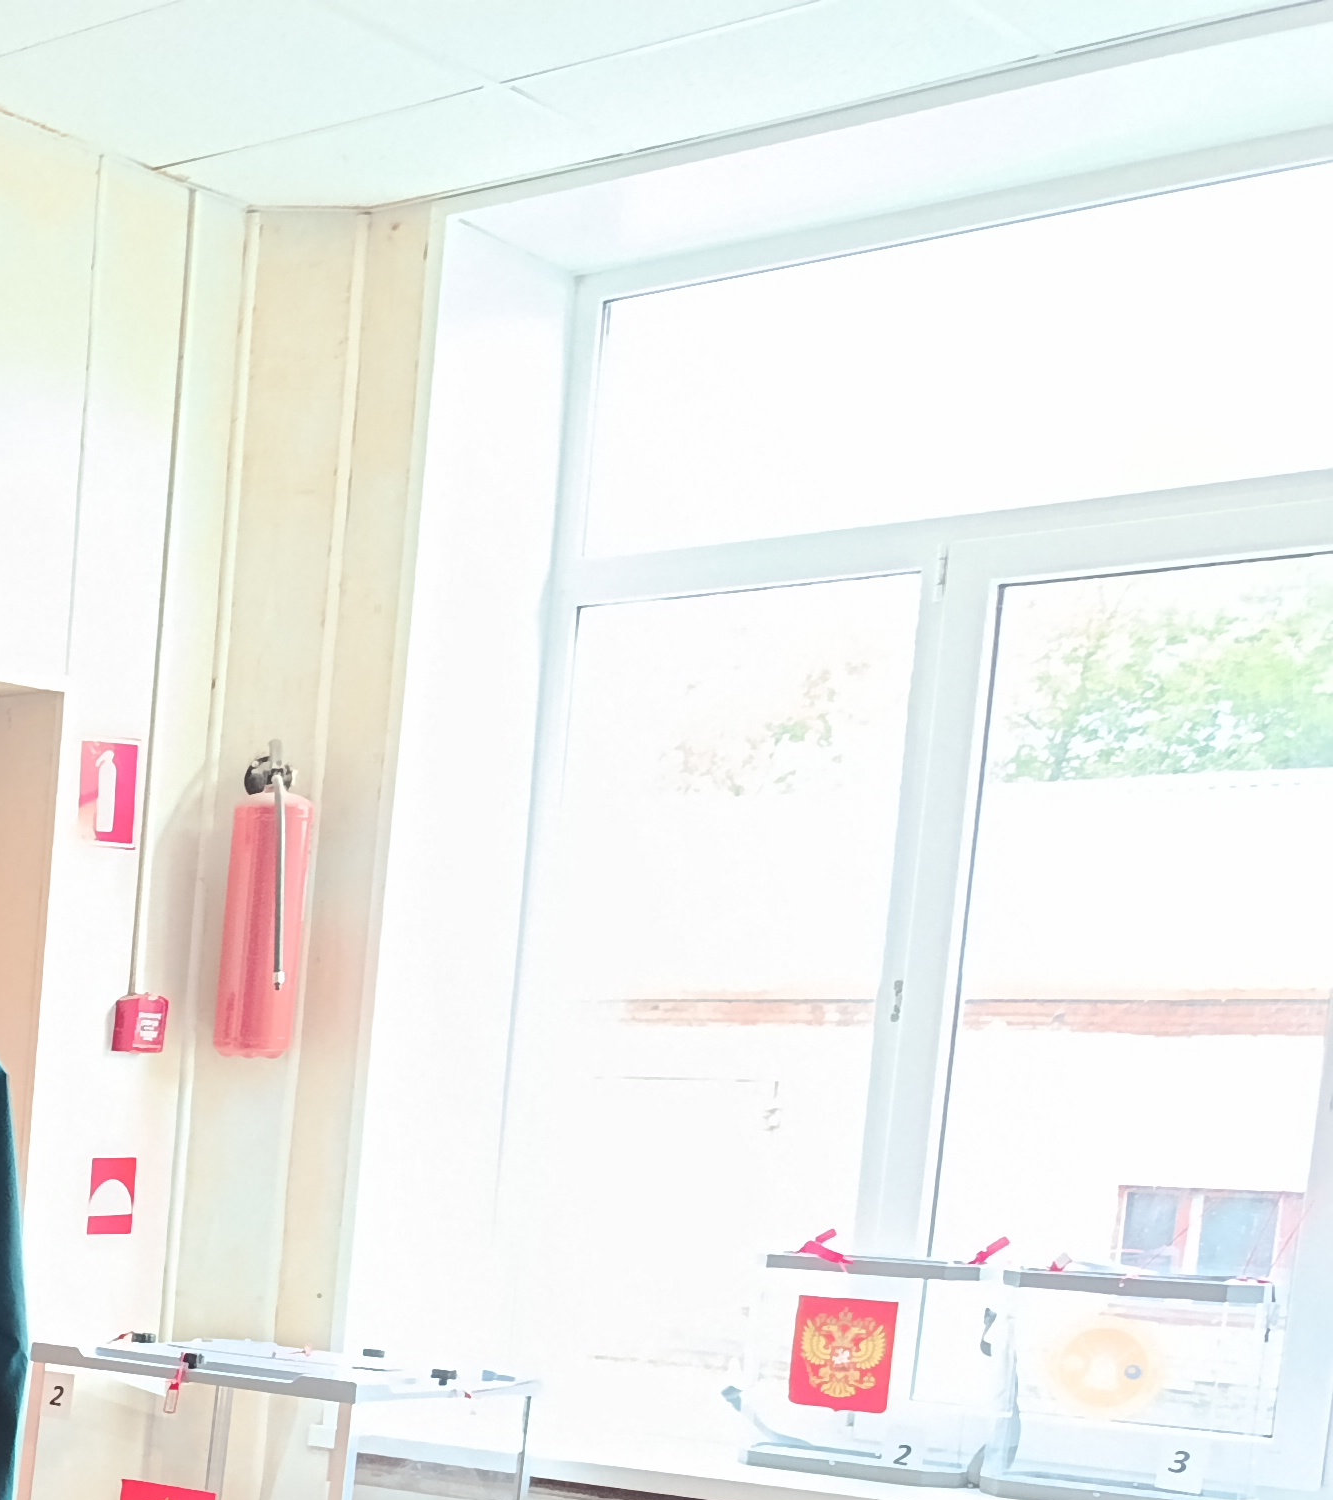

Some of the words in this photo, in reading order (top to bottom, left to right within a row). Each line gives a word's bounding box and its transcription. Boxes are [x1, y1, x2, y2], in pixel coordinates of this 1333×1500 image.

[49, 1385, 65, 1407] 2
[892, 1444, 912, 1466] 2
[1167, 1450, 1191, 1474] 3
